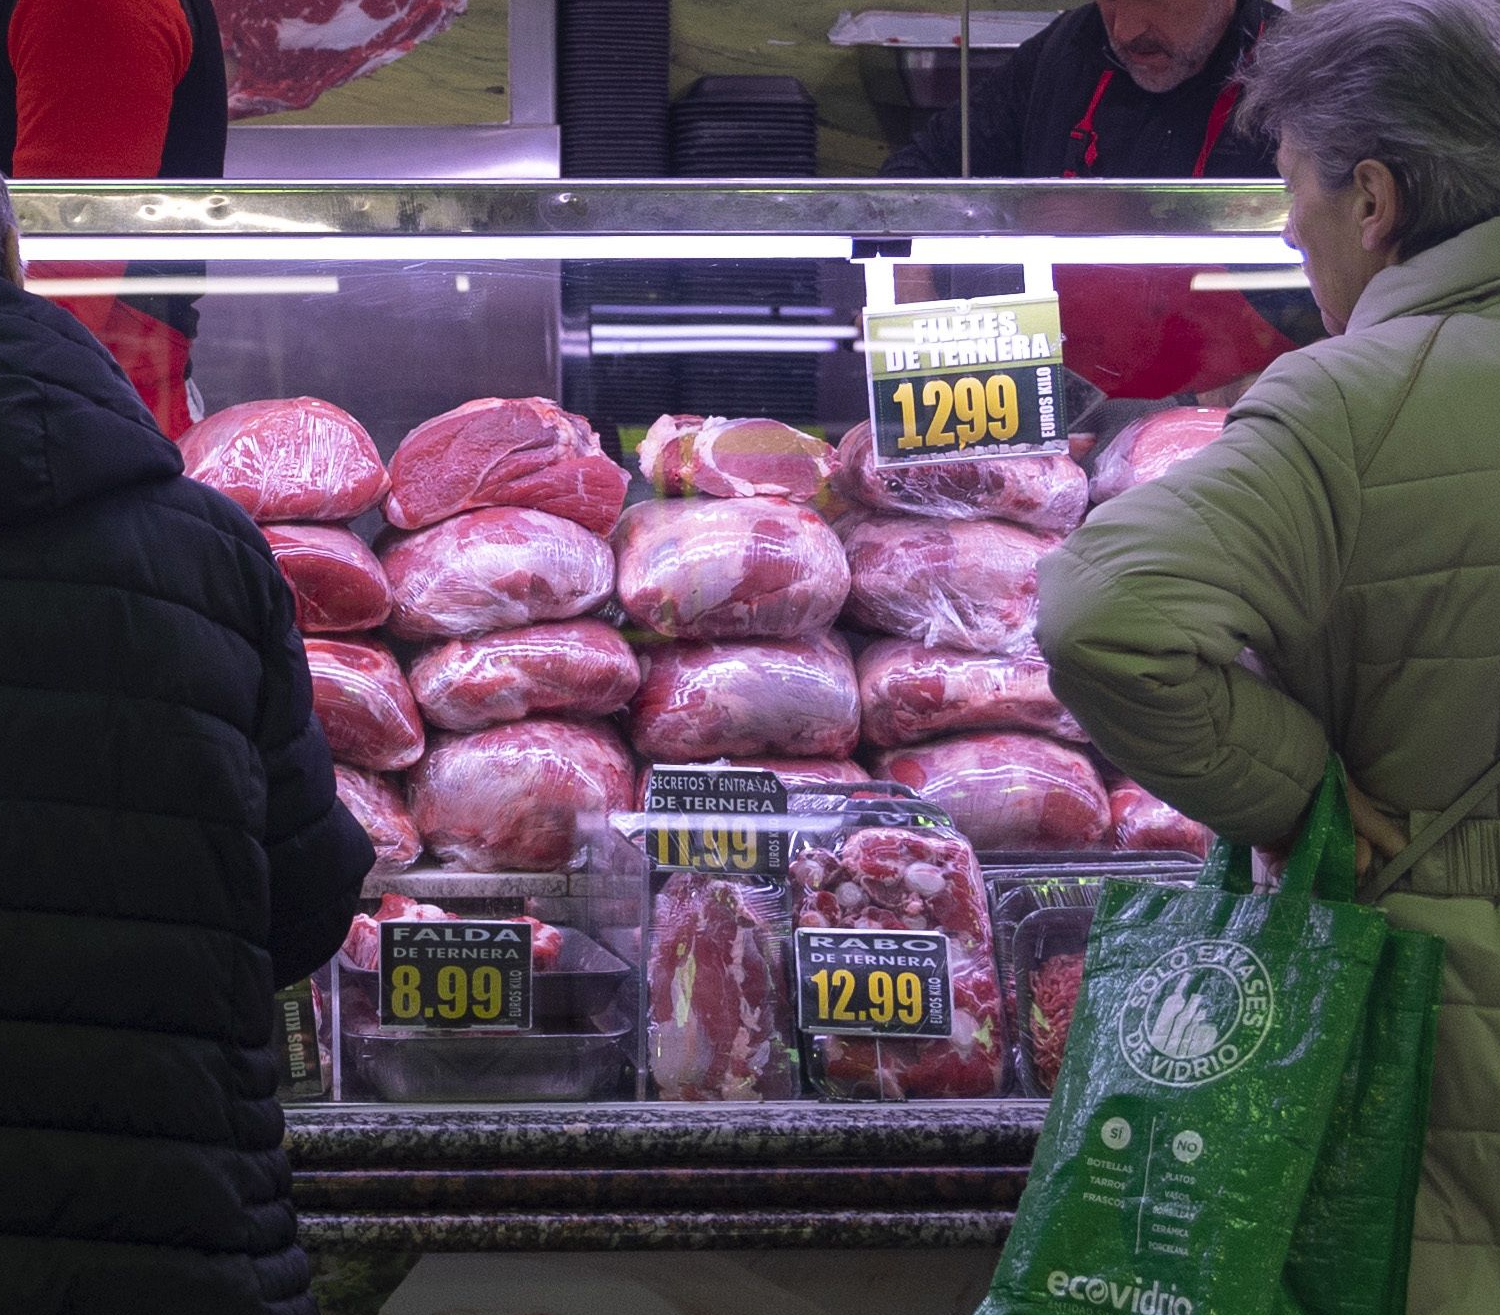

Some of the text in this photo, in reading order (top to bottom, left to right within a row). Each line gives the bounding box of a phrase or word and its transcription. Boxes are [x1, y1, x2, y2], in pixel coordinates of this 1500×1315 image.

[913, 311, 1018, 345] FILETES
[886, 333, 1051, 372] DE TERNERA
[393, 928, 522, 942] FALDA
[810, 936, 938, 952] RABO
[393, 947, 519, 959] DE TERNERA
[811, 953, 938, 968] DE TERNERA
[391, 965, 502, 1019] 8.99
[811, 968, 923, 1024] 12.99
[1129, 951, 1191, 1010] SOLO
[1127, 1031, 1240, 1083] DE VIDRIO
[1176, 1140, 1197, 1152] NO
